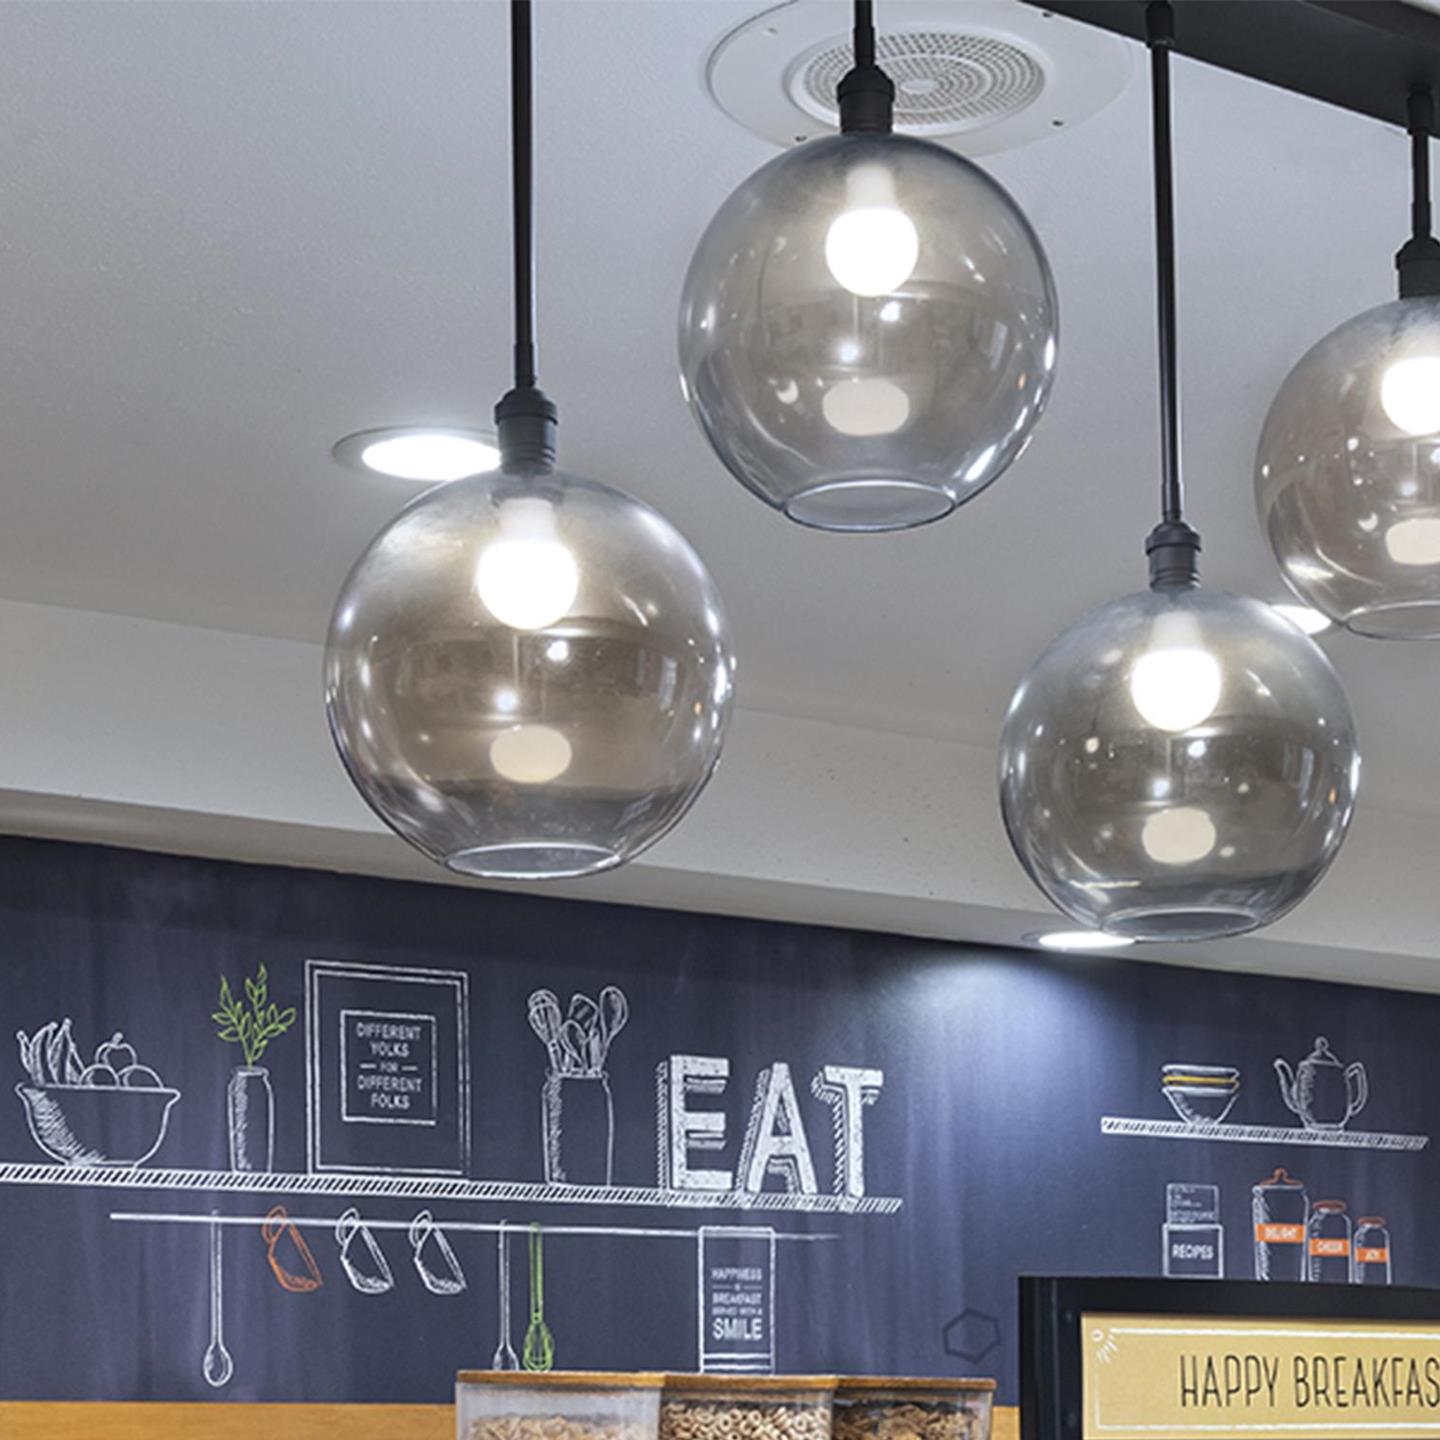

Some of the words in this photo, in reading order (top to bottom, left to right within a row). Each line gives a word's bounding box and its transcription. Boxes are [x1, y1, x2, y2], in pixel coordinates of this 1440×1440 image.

[356, 1022, 421, 1040] DIFFERENT
[369, 1041, 409, 1058] YOLKS
[357, 1074, 423, 1093] DIFFERENT
[371, 1092, 410, 1110] FOLKS
[657, 1054, 884, 1200] EAT
[1172, 1244, 1214, 1260] RECIPES
[712, 1317, 763, 1340] SMILE
[1180, 1355, 1279, 1407] HAPPY
